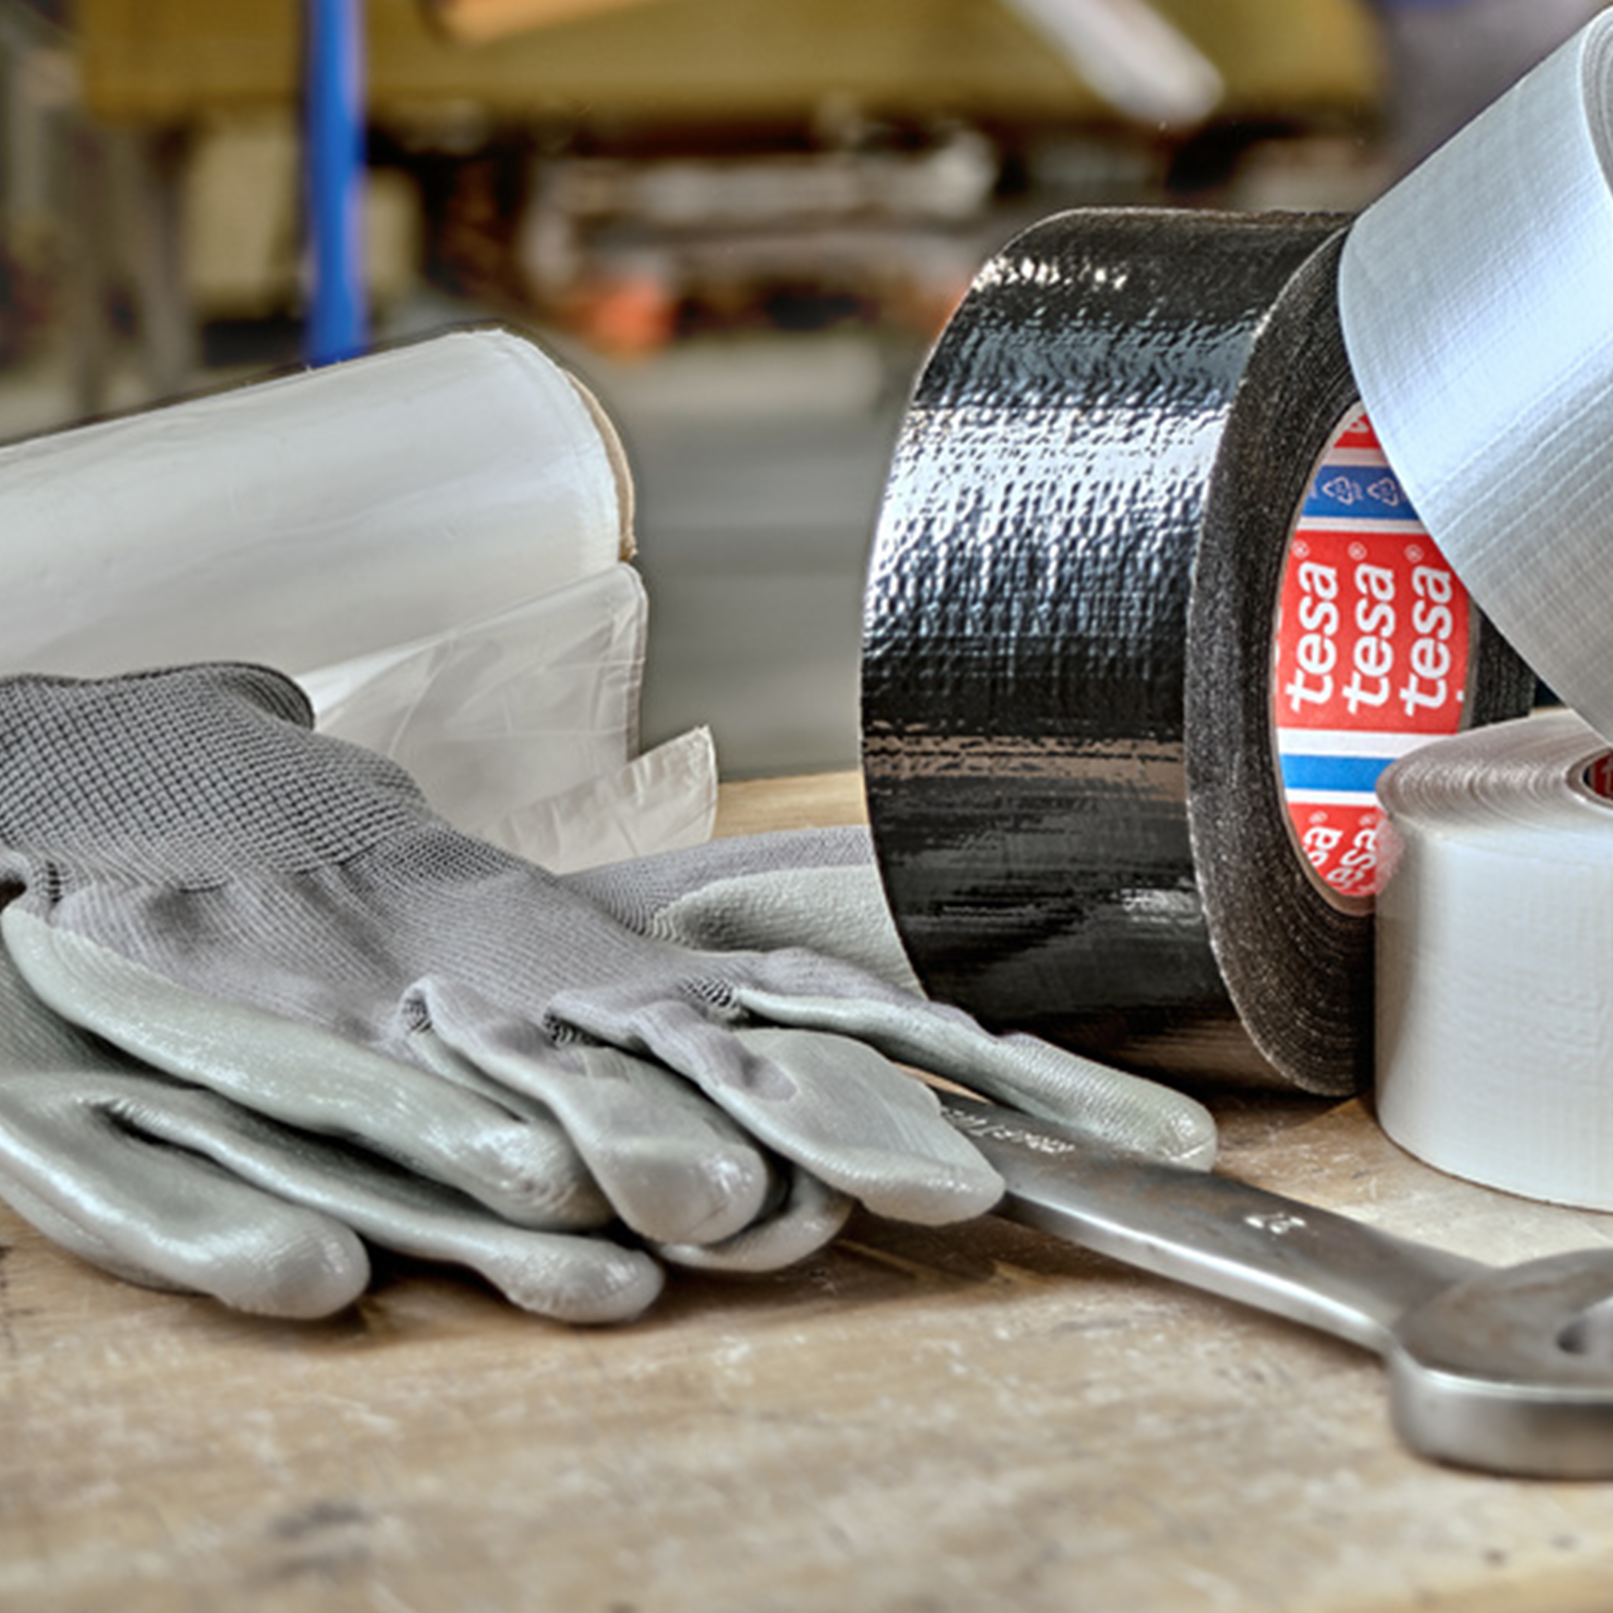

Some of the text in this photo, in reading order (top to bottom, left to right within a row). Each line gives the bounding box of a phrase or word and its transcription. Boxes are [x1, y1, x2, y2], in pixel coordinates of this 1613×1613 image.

[1285, 561, 1339, 714] tesa
[1342, 563, 1396, 716] tesa
[1399, 565, 1454, 718] tesa
